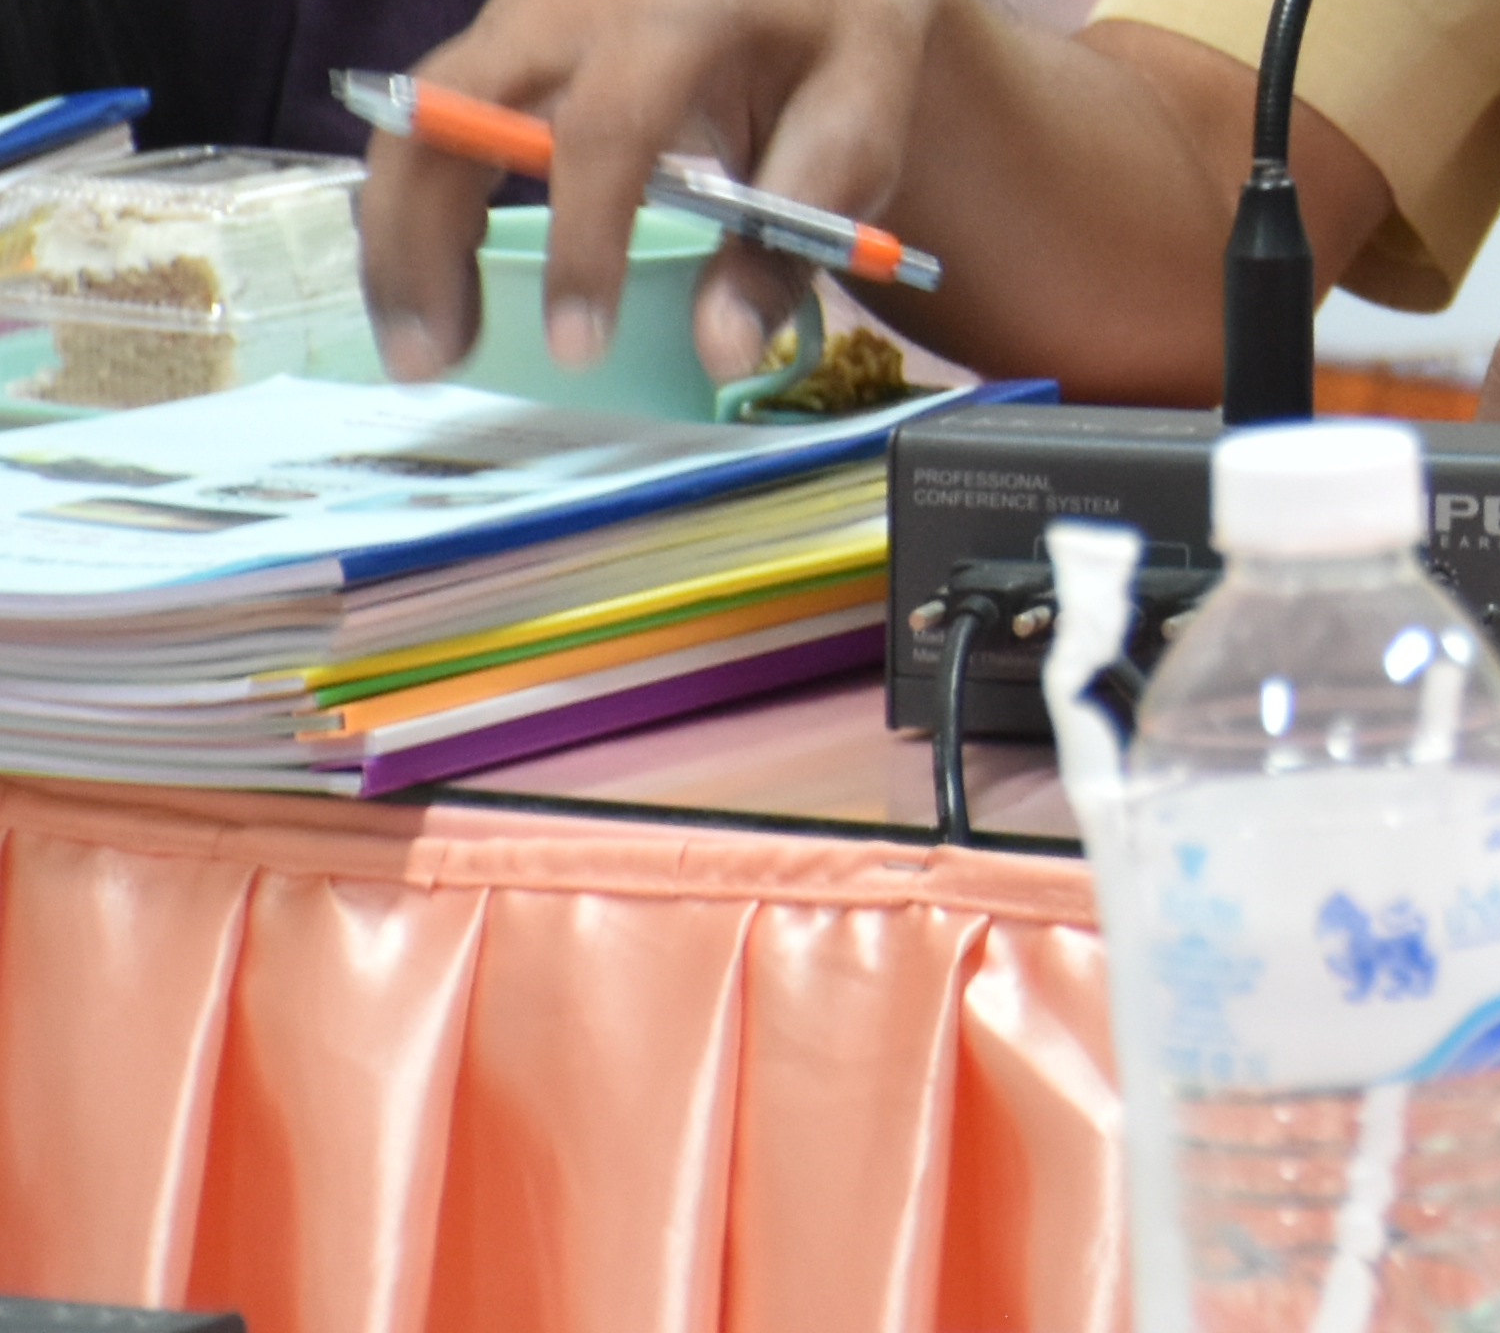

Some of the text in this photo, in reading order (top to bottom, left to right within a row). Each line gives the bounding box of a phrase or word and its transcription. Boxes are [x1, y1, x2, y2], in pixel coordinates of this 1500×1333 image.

[913, 467, 1052, 491] PROFESSIONAL
[913, 488, 1121, 515] CONFERENCE SYSTEM
